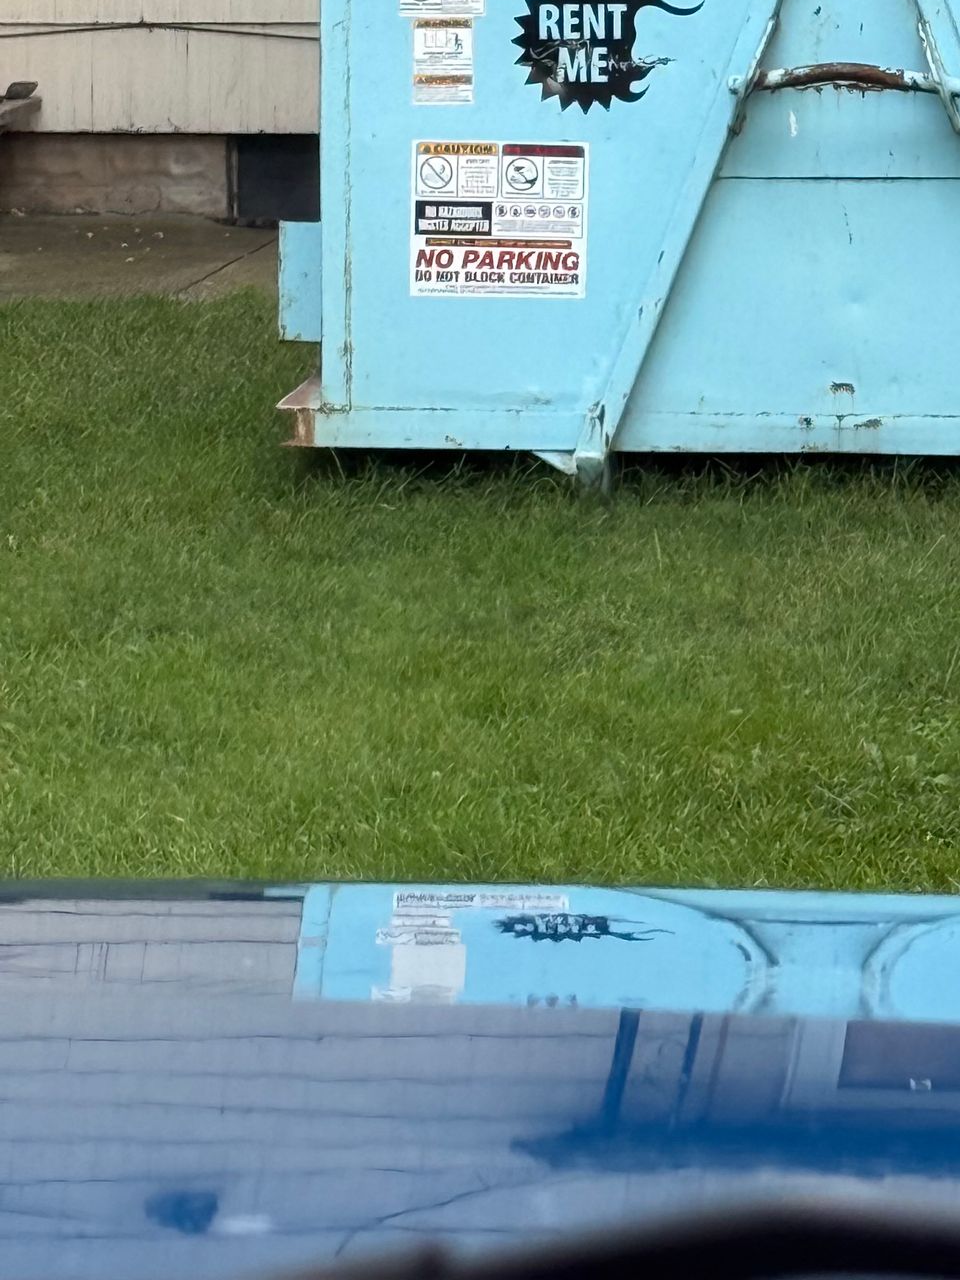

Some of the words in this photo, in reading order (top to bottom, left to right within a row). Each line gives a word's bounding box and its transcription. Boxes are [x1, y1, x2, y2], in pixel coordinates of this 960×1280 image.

[538, 3, 627, 40] RENT
[556, 46, 609, 83] ME
[415, 249, 454, 269] NO
[461, 250, 580, 271] PARKING
[415, 269, 432, 283] DO
[436, 270, 460, 283] NOT
[465, 271, 505, 284] BLOCK
[509, 271, 580, 285] CONTAINER
